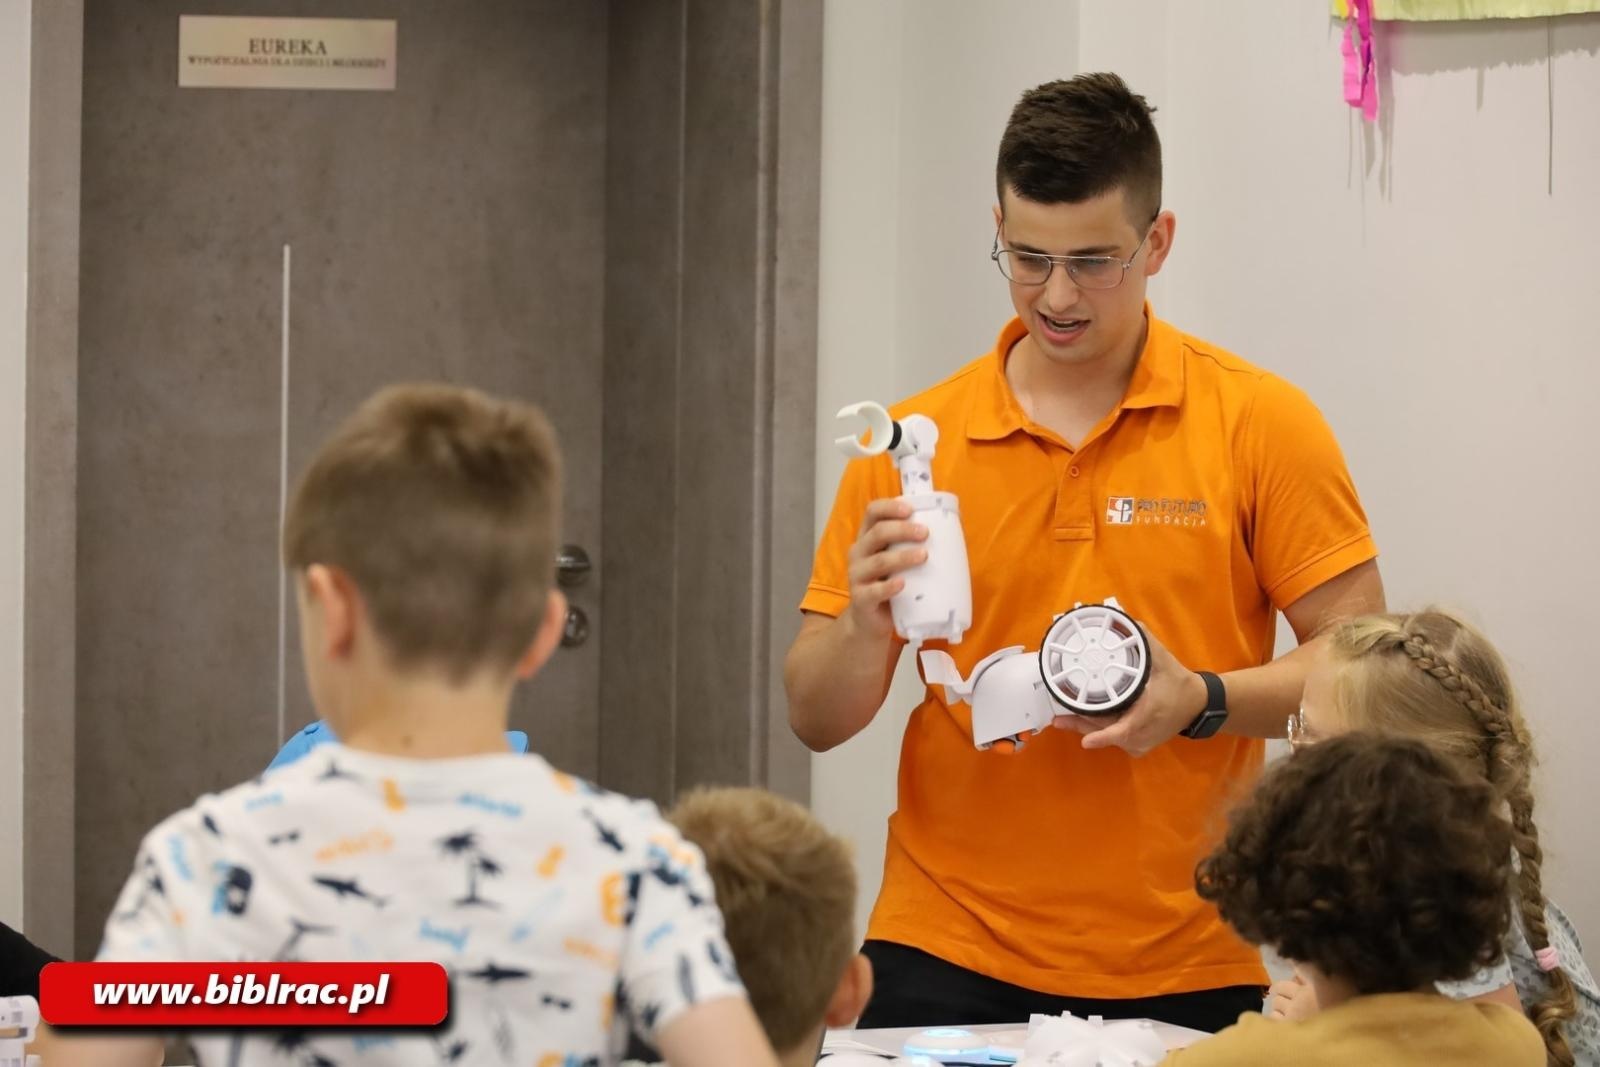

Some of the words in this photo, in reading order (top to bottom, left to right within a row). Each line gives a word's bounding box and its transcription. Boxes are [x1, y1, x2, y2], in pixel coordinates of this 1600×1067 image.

[248, 38, 327, 55] EUREKA
[1137, 499, 1158, 514] PRO
[1161, 499, 1207, 516] FUTURO
[1136, 515, 1206, 526] FUNDACJA
